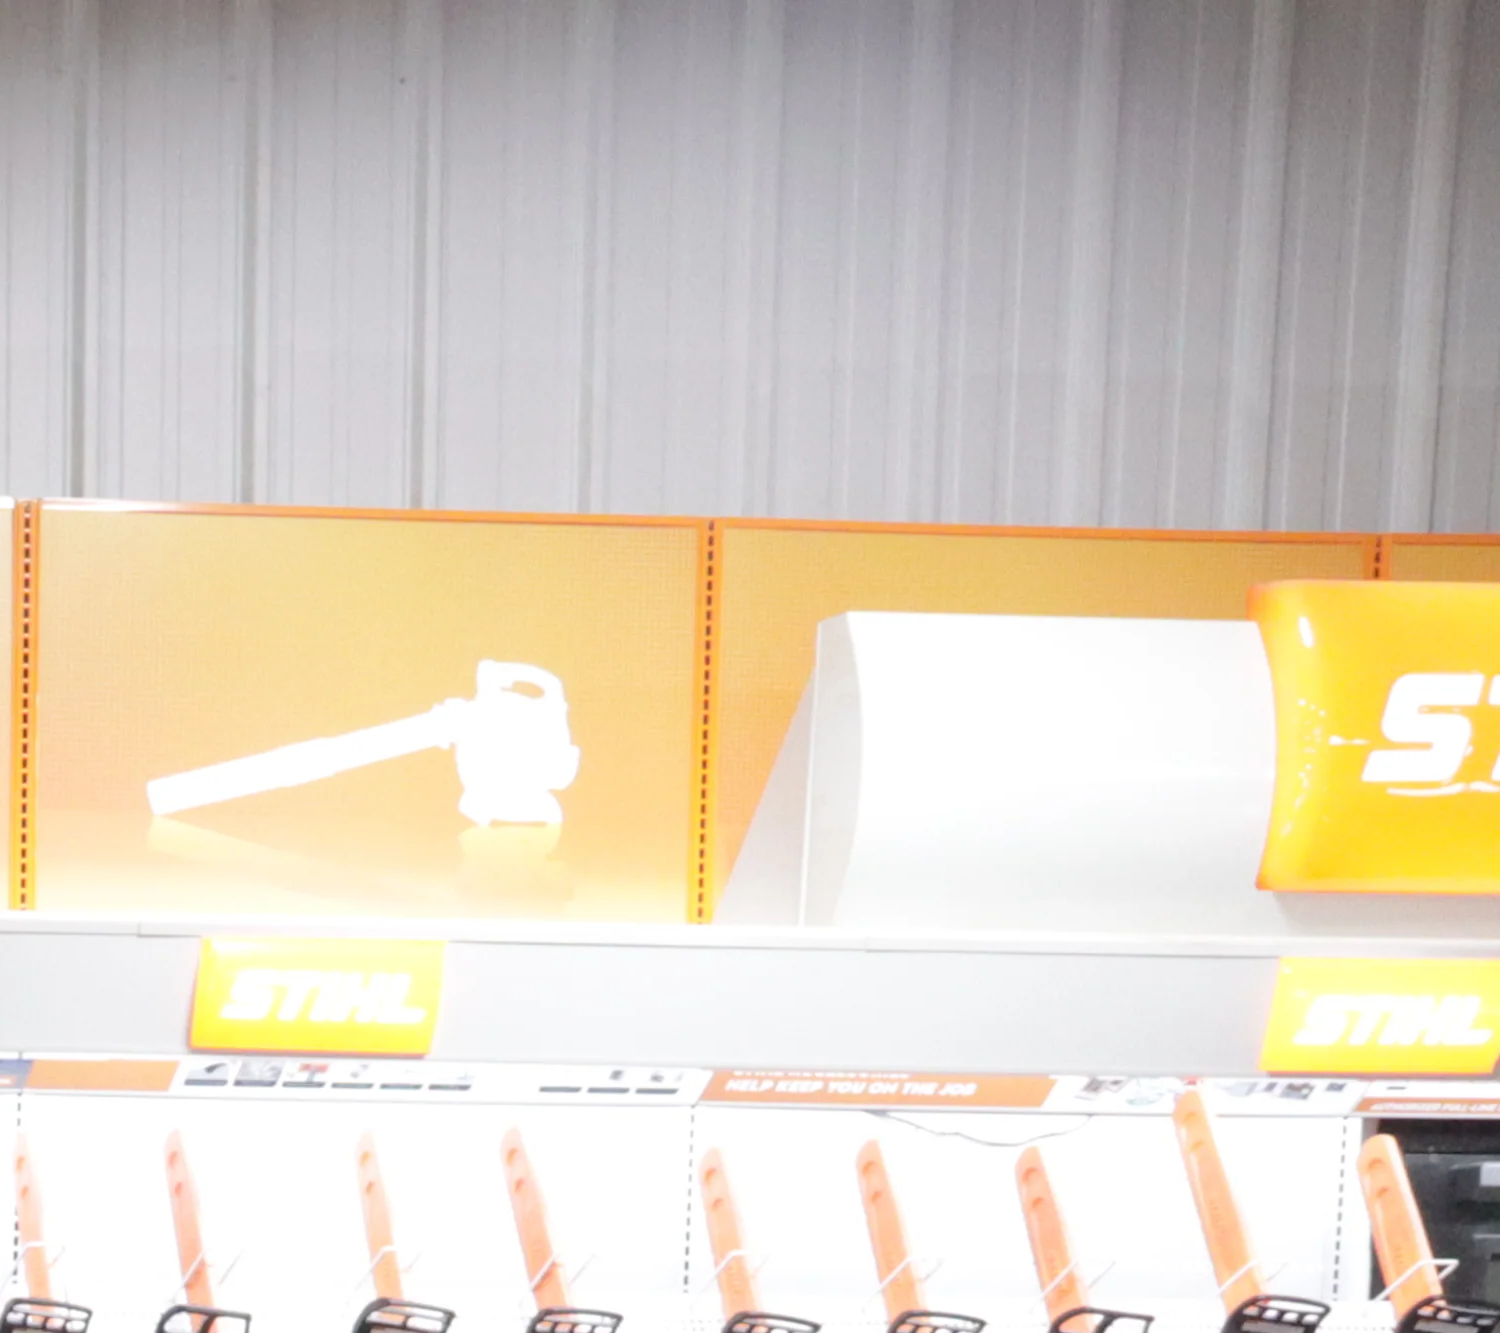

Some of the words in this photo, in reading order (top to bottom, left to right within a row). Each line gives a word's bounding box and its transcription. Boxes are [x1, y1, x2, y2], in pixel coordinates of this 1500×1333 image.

[1362, 673, 1500, 782] S
[221, 968, 426, 1024] STIHL
[1293, 994, 1493, 1045] STIHL
[725, 1079, 774, 1092] HELP
[776, 1080, 824, 1093] KEEP
[828, 1080, 864, 1094] YOU
[868, 1081, 899, 1094] ON
[902, 1082, 937, 1096] THE
[939, 1082, 979, 1096] JOB
